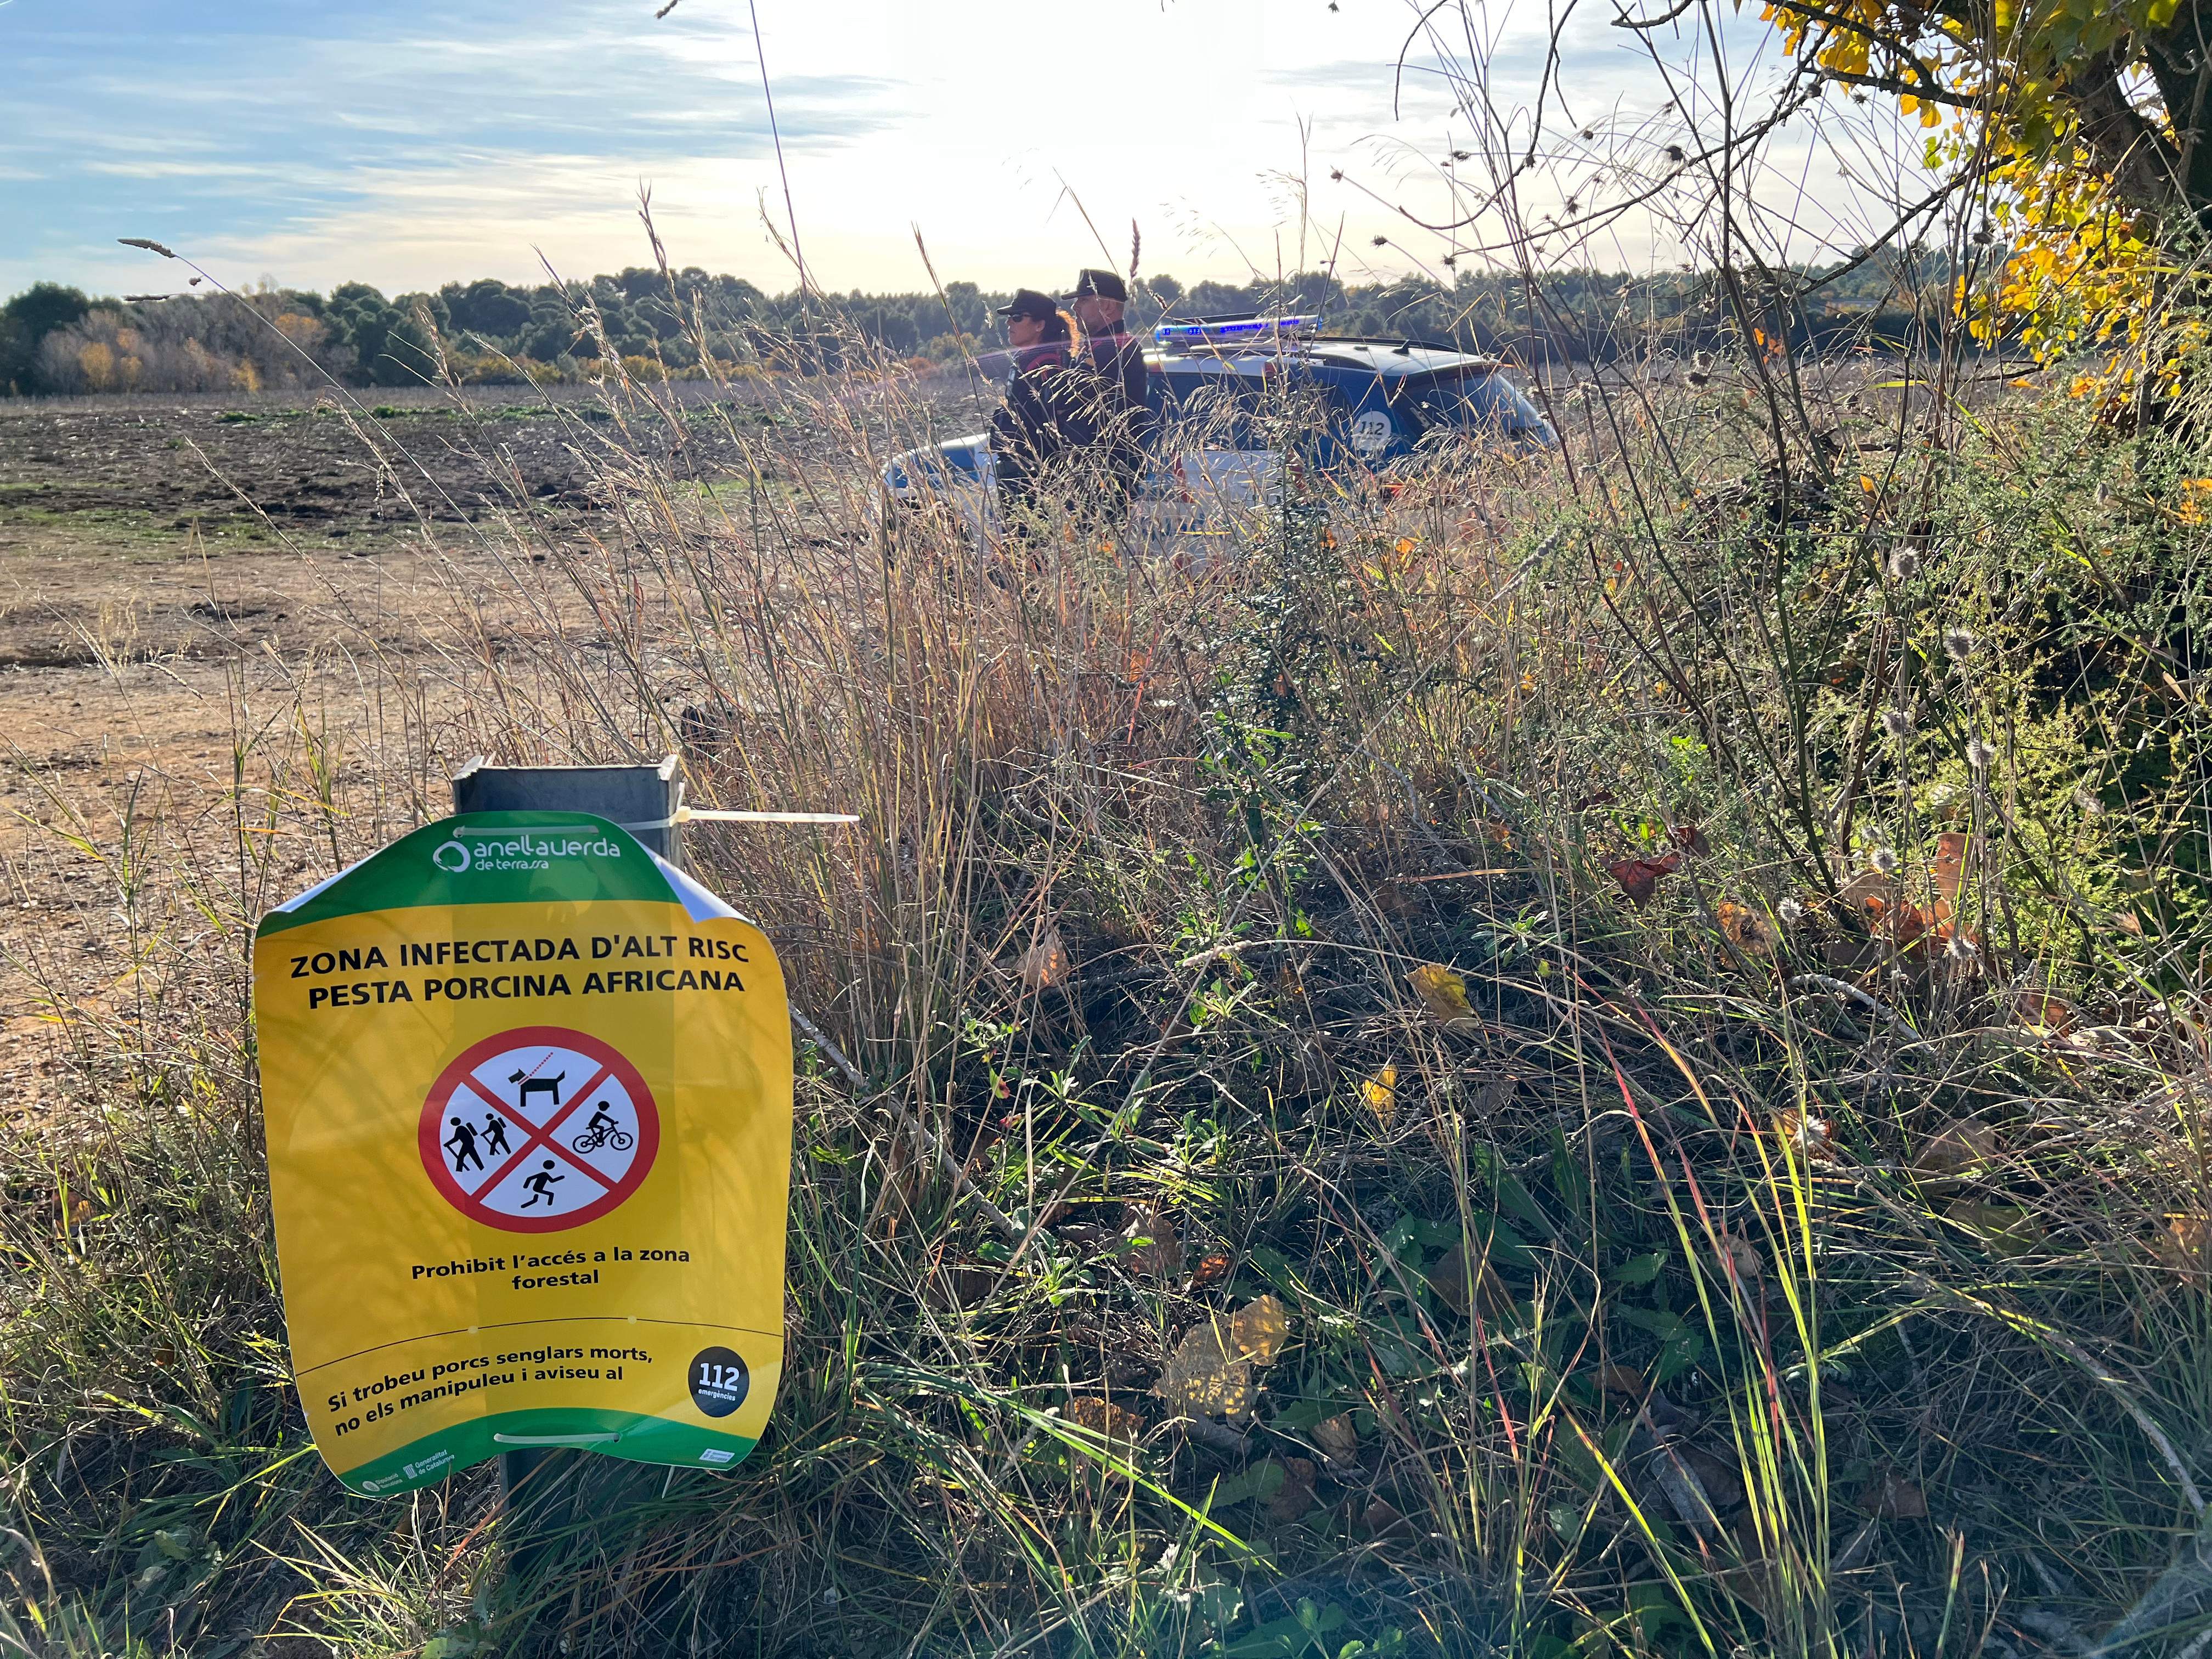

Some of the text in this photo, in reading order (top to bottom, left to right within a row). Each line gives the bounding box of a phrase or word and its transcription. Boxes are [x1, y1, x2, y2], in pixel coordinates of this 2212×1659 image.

[475, 859, 549, 871] de terrassa
[290, 934, 749, 979] ZONA INFECTADA D'ALT RISC
[308, 969, 745, 1009] PESTA PORCINA AFRICANA
[411, 1256, 506, 1280] Prohibit
[593, 1251, 606, 1262] a
[613, 1246, 633, 1262] la
[639, 1250, 690, 1263] zona
[511, 1269, 599, 1290] forestal
[328, 1346, 653, 1413] Si trobeu porcs senglars morts,
[699, 1363, 740, 1392] 112
[335, 1365, 623, 1437] no els manipuleu i aviseu al
[698, 1389, 736, 1401] emergències
[415, 1449, 448, 1469] Generalitat
